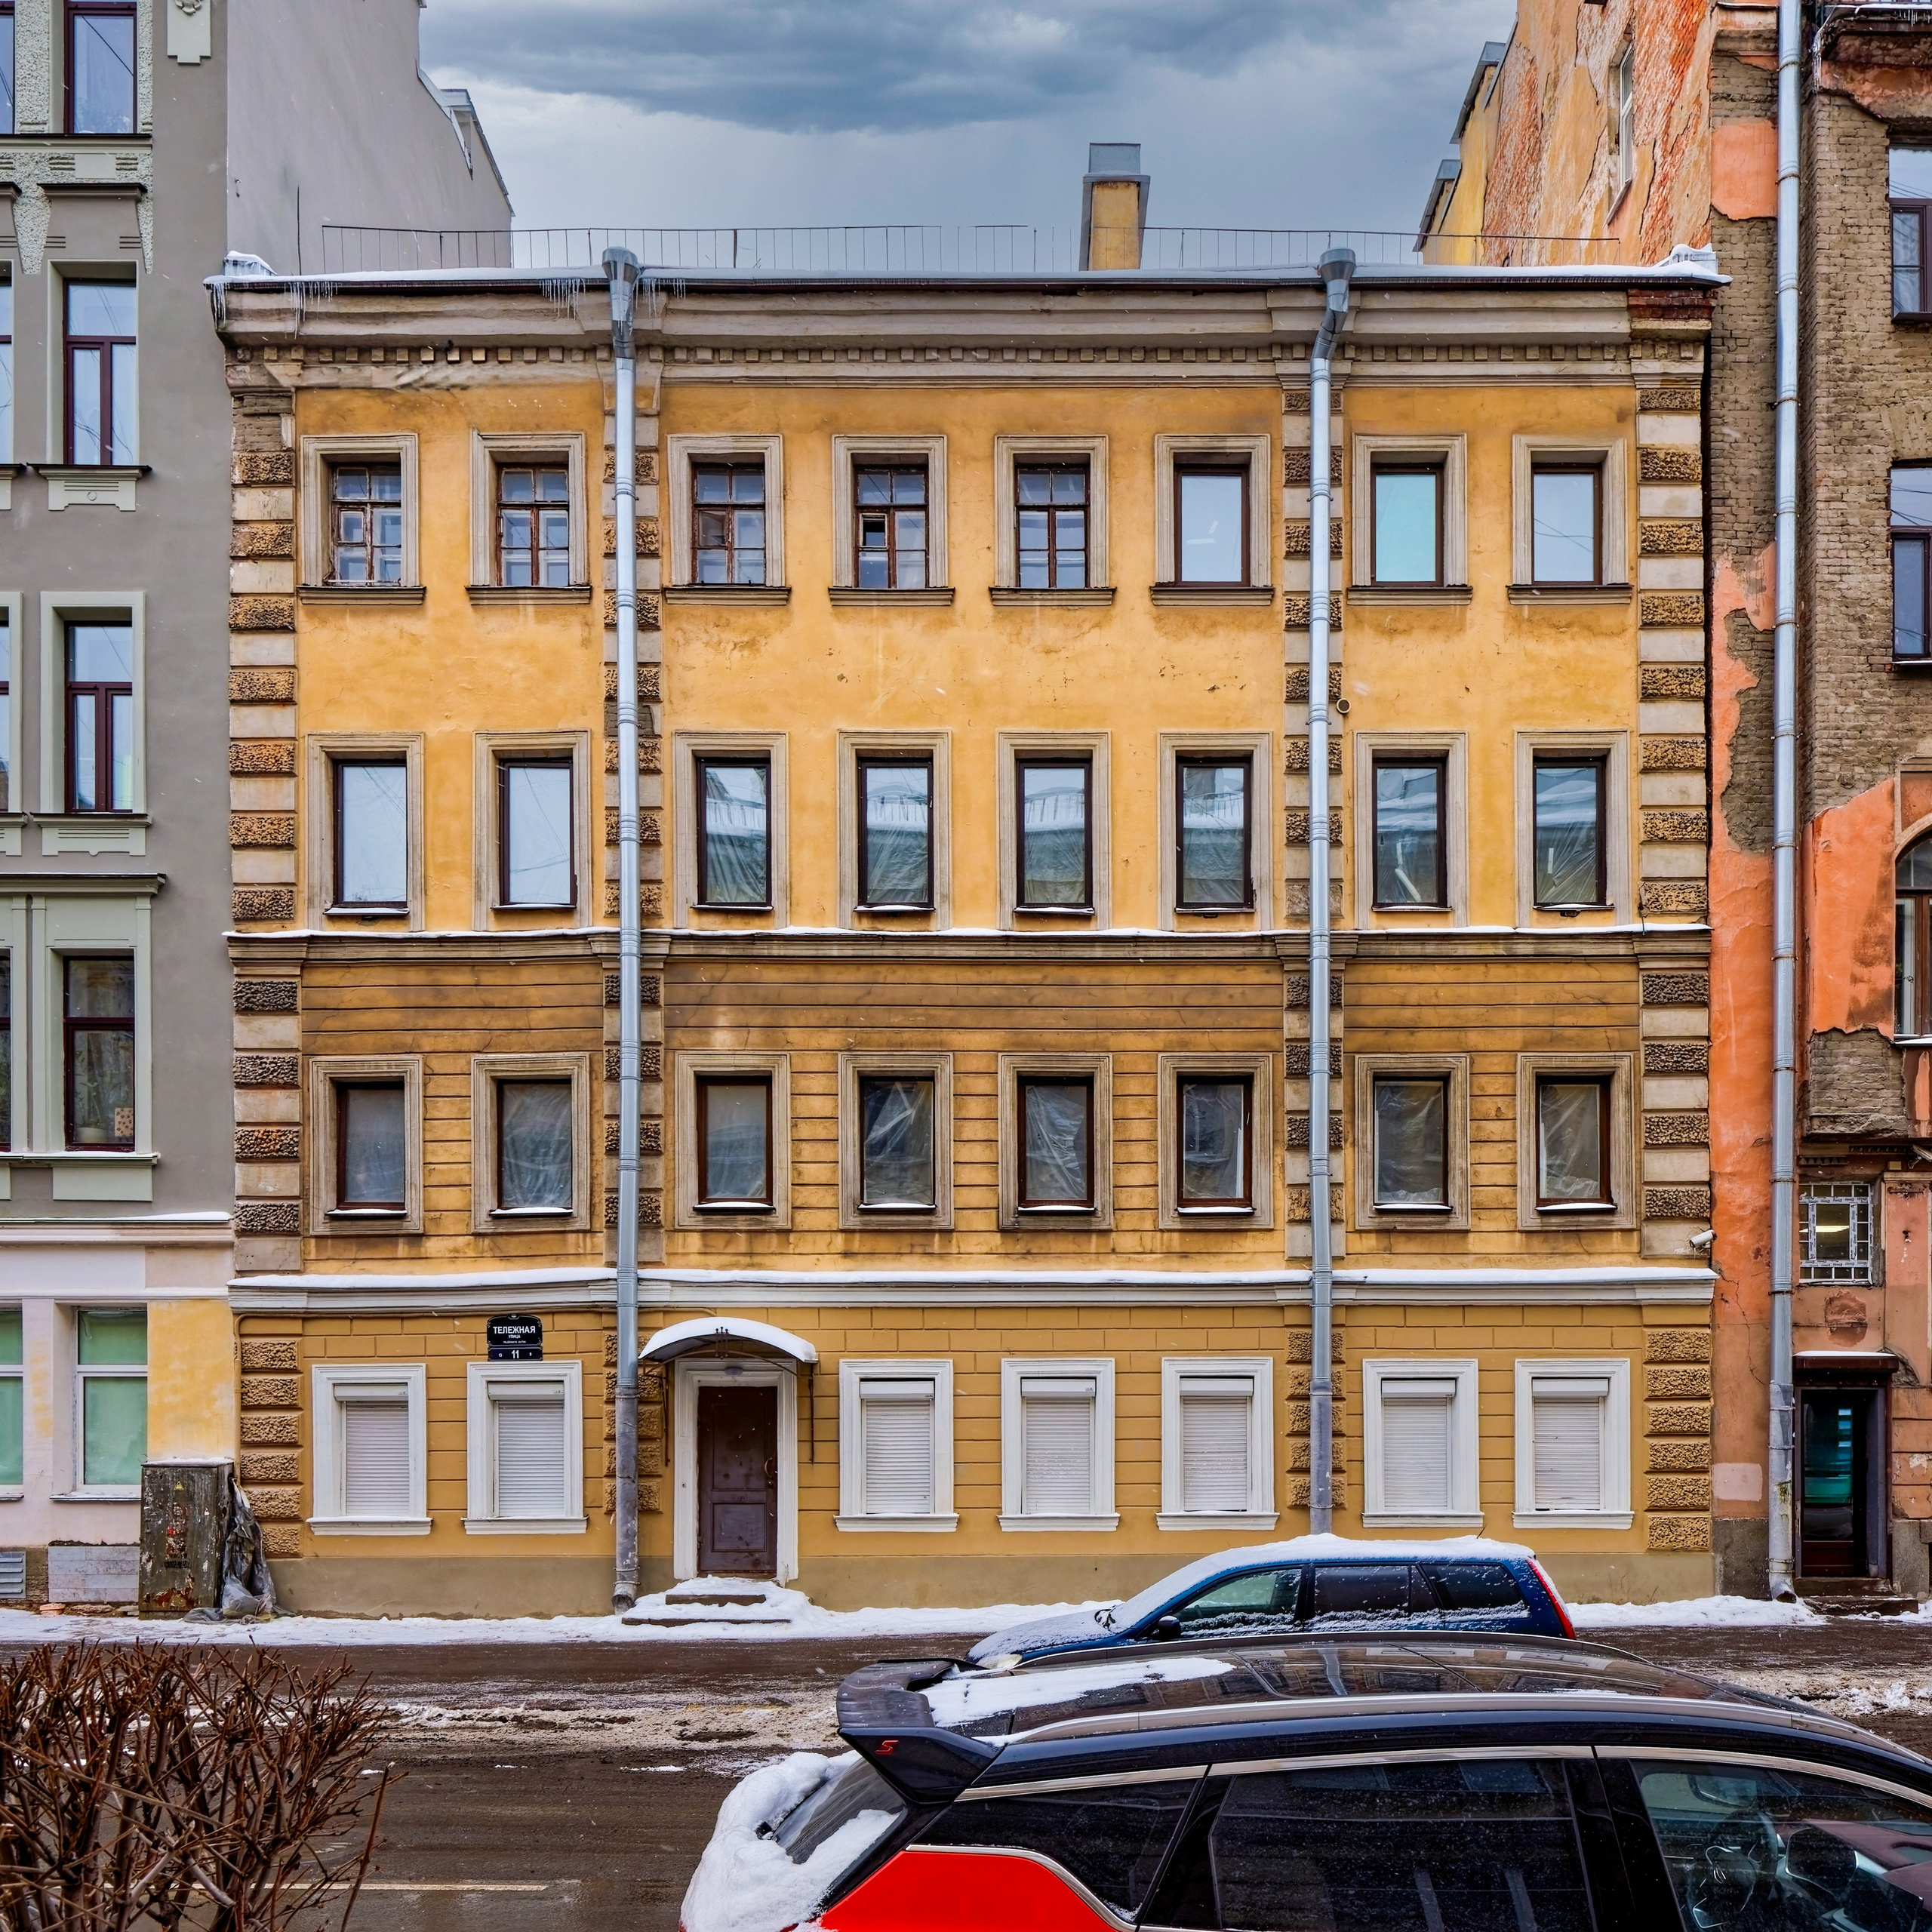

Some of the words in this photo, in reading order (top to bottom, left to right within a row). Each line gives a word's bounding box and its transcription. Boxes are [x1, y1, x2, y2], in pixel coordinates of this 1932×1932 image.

[493, 1326, 535, 1334] ТЕЛЕЖНАЯ
[511, 1349, 519, 1358] 11
[875, 1740, 899, 1755] S
